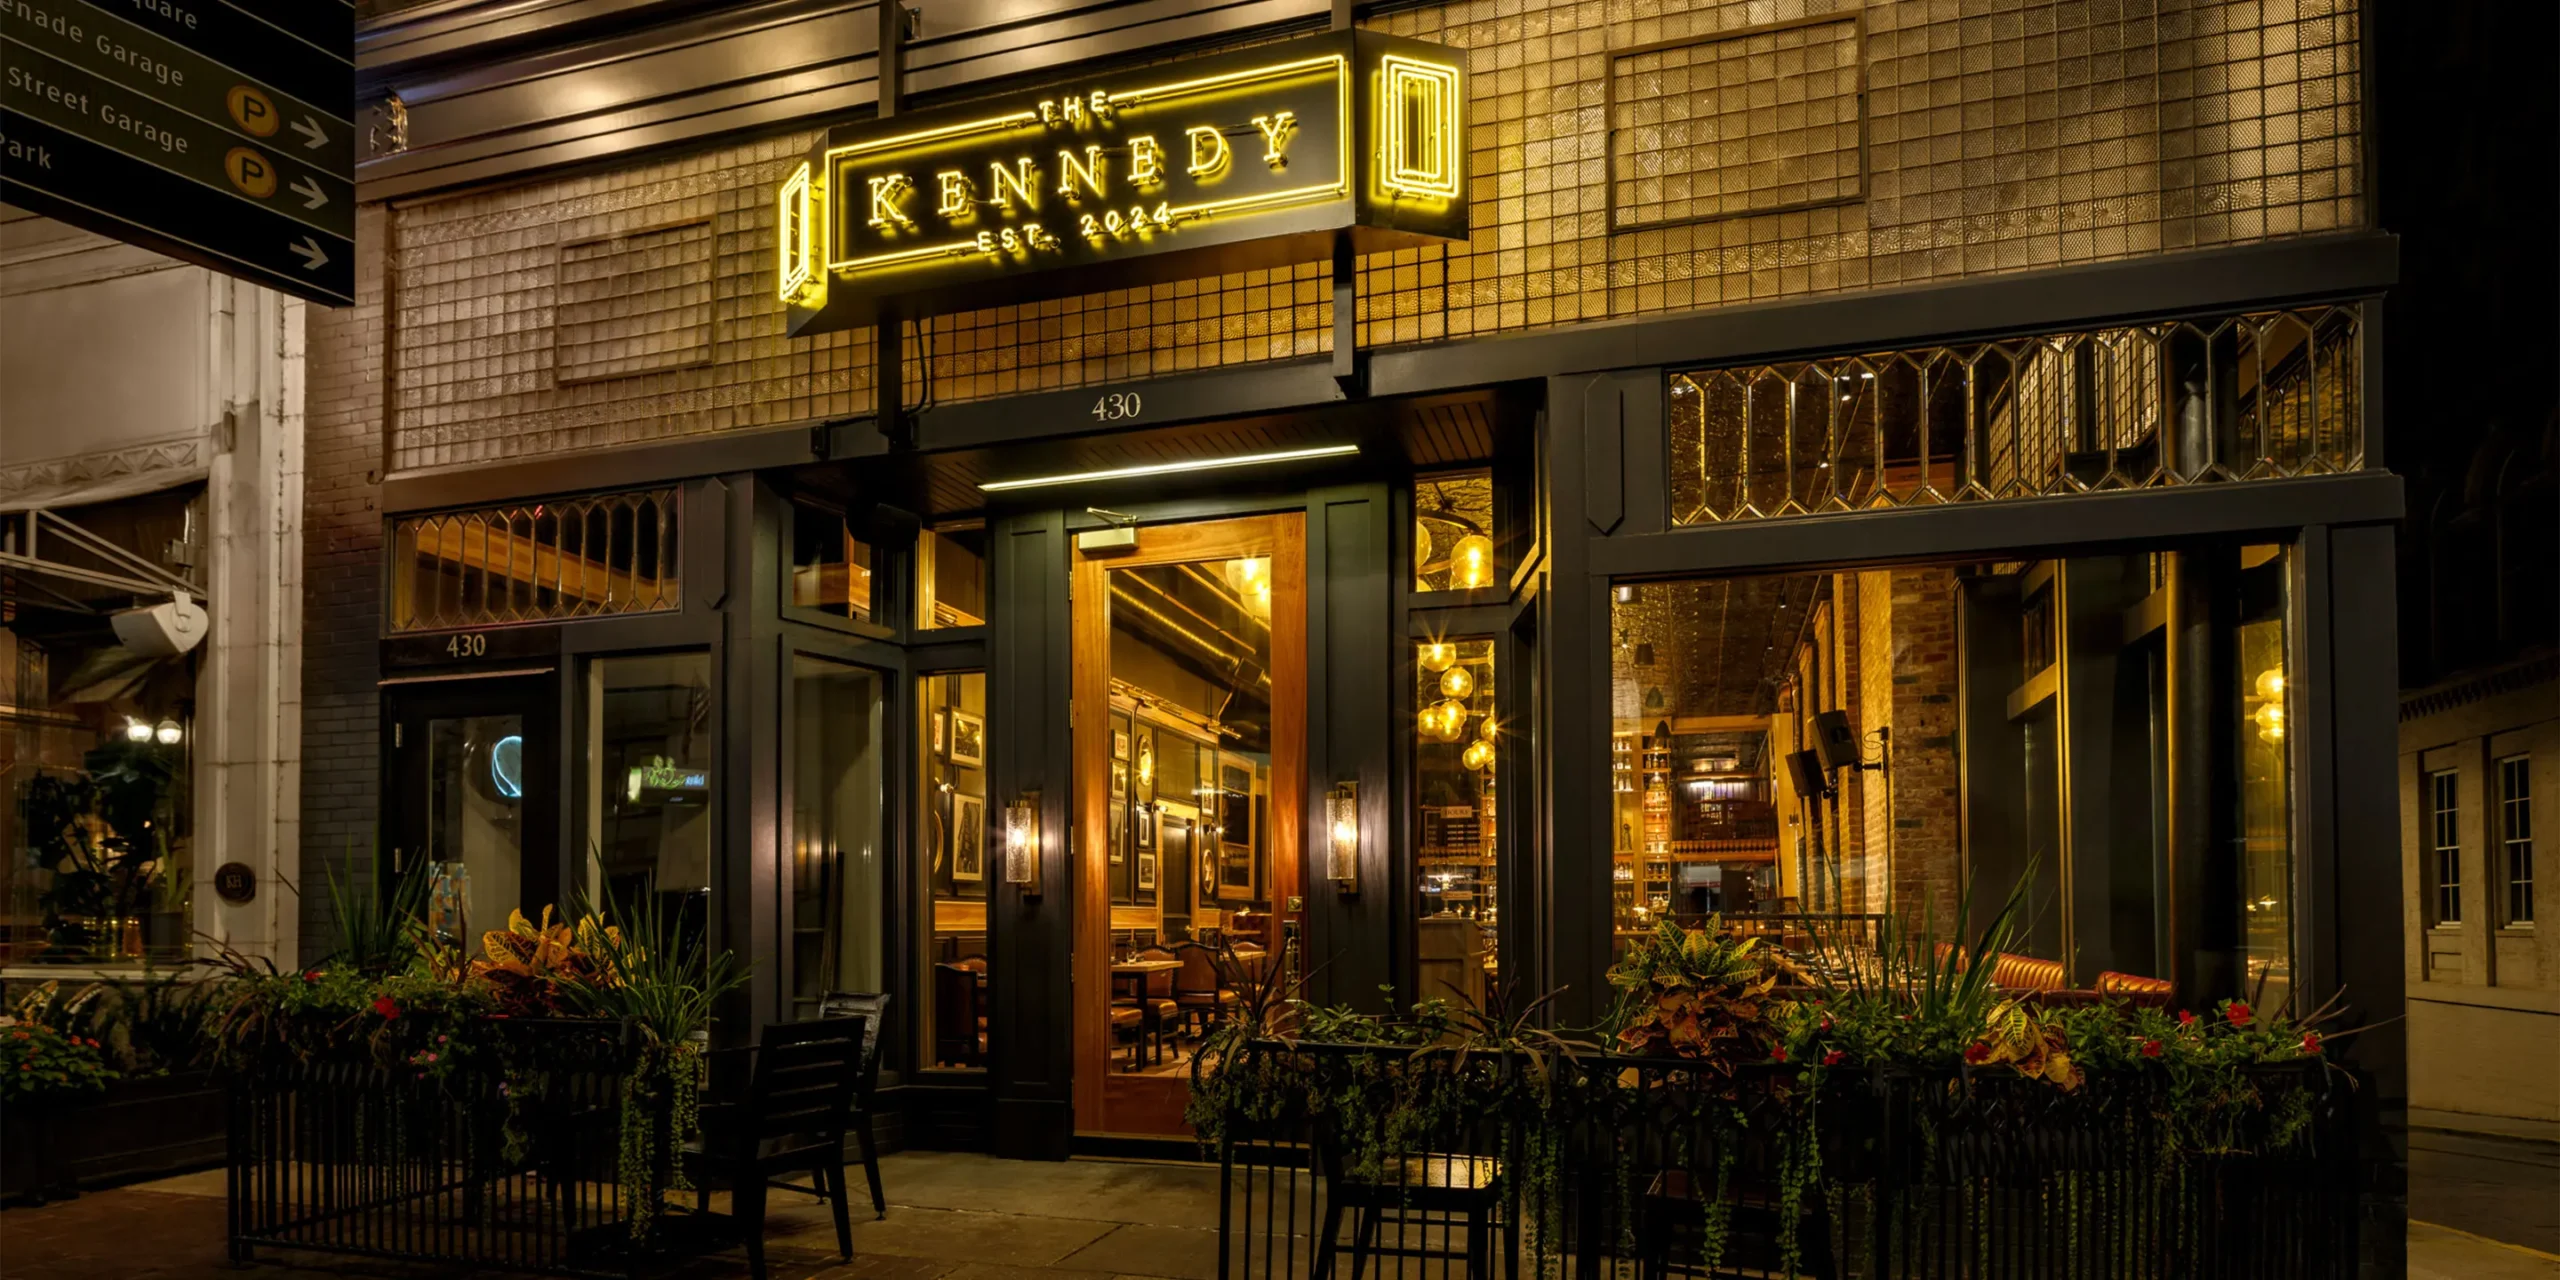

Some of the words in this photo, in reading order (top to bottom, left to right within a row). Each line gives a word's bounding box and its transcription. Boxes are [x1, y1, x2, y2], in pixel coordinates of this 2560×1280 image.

[96, 34, 184, 87] Garage
[243, 95, 266, 123] P
[1039, 91, 1106, 122] THE
[8, 67, 89, 115] Street
[101, 105, 188, 154] Garage
[241, 157, 264, 185] P
[867, 112, 1294, 226] KENNEDY
[1081, 202, 1170, 236] 2024
[1091, 392, 1141, 421] 430
[446, 634, 486, 658] 430
